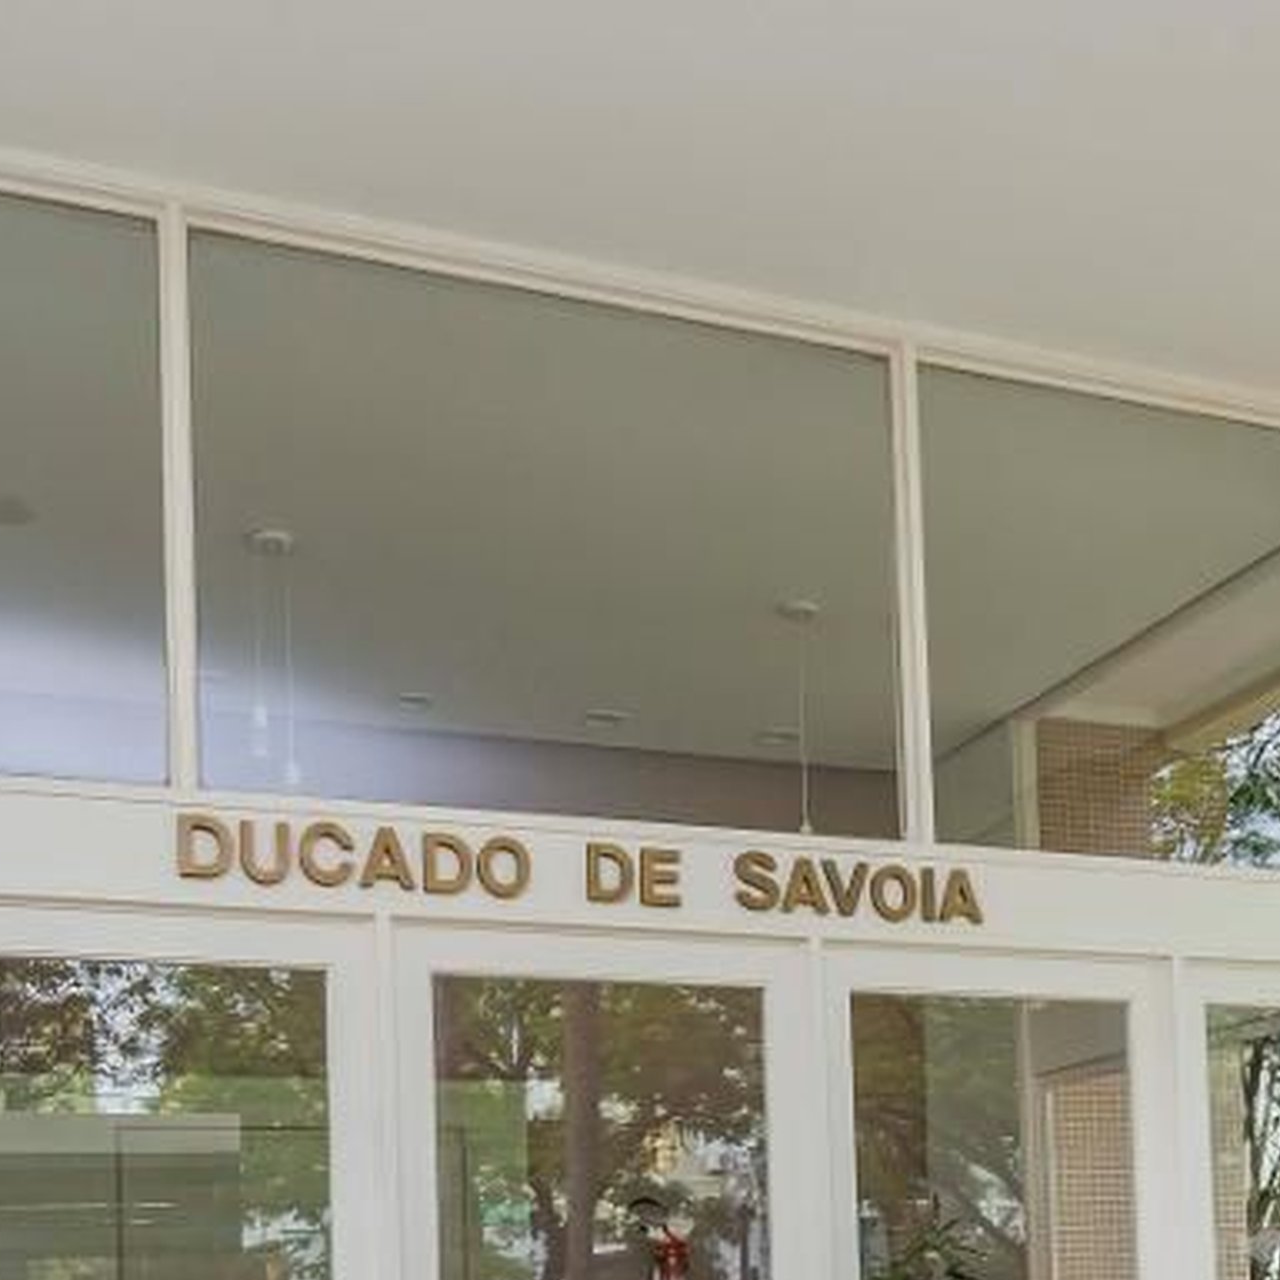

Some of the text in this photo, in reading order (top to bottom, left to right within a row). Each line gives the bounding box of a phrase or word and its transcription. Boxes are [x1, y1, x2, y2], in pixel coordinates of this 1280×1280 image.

[177, 813, 983, 925] DUCADO DE SAVOIA
